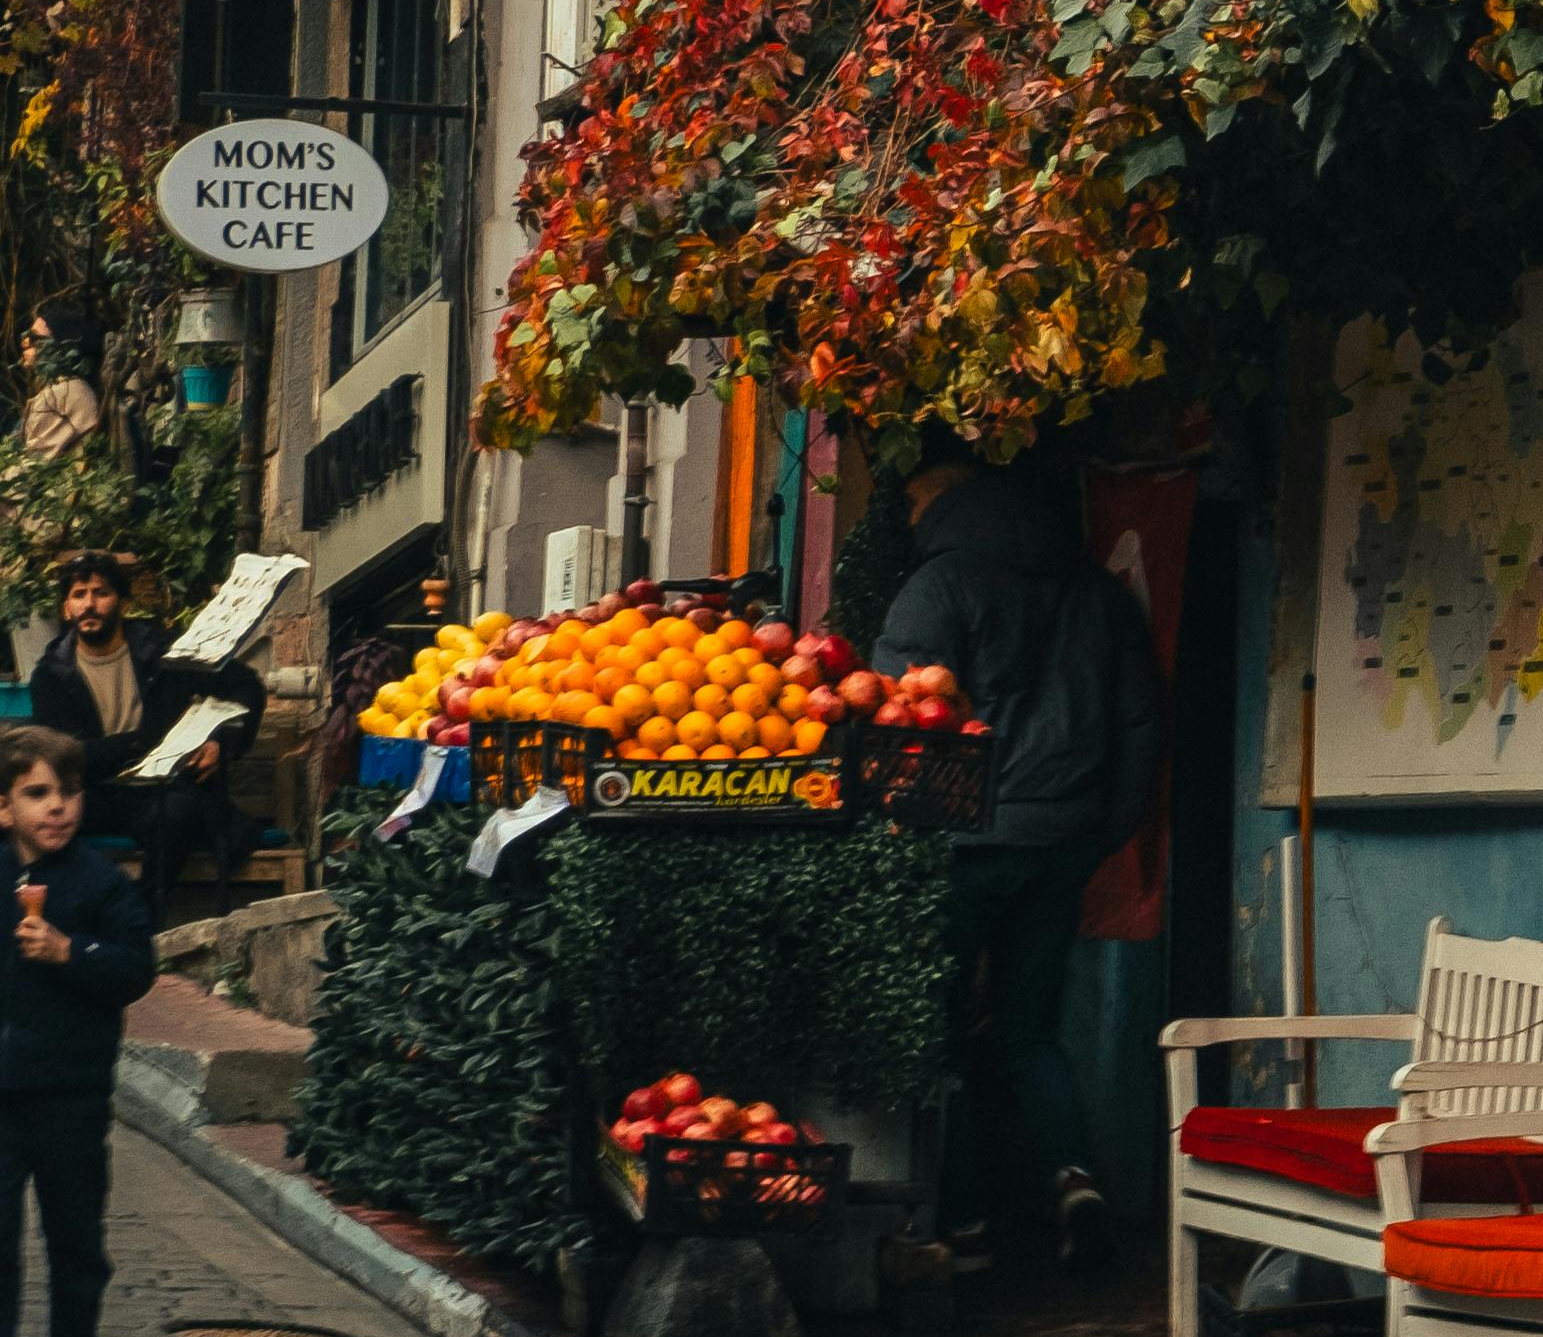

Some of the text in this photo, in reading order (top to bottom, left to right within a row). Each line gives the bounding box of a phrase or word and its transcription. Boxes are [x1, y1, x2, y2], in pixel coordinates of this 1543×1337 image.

[214, 139, 336, 171] MOM'S
[196, 179, 354, 212] KITCHEN
[222, 219, 315, 251] CAFE
[630, 767, 792, 797] KARACAN
